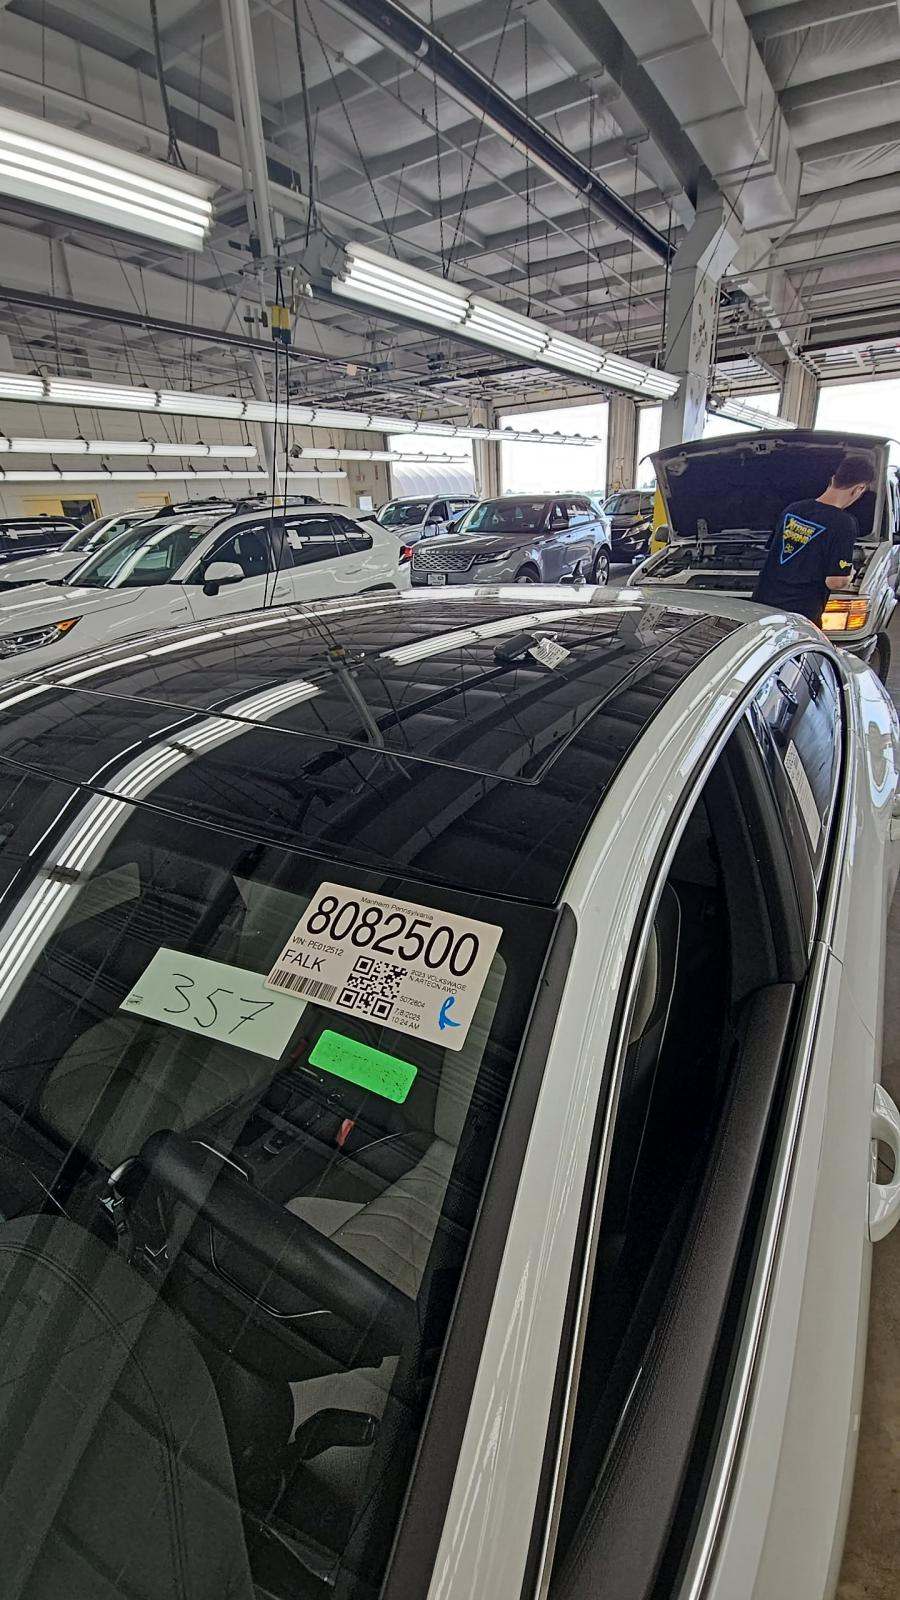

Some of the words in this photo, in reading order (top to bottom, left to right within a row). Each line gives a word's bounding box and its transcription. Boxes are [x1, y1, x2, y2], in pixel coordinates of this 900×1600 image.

[360, 896, 390, 908] Manheim
[391, 904, 434, 921] Pennsylvania
[306, 896, 480, 976] 8082500
[307, 940, 344, 957] PE012512
[281, 949, 326, 972] FALK
[410, 969, 426, 977] 2023
[427, 973, 467, 991] VOLKSWAGE
[414, 977, 441, 990] ARTEON
[441, 985, 458, 995] AWD
[163, 973, 274, 1034] 357
[409, 1022, 420, 1030] AM
